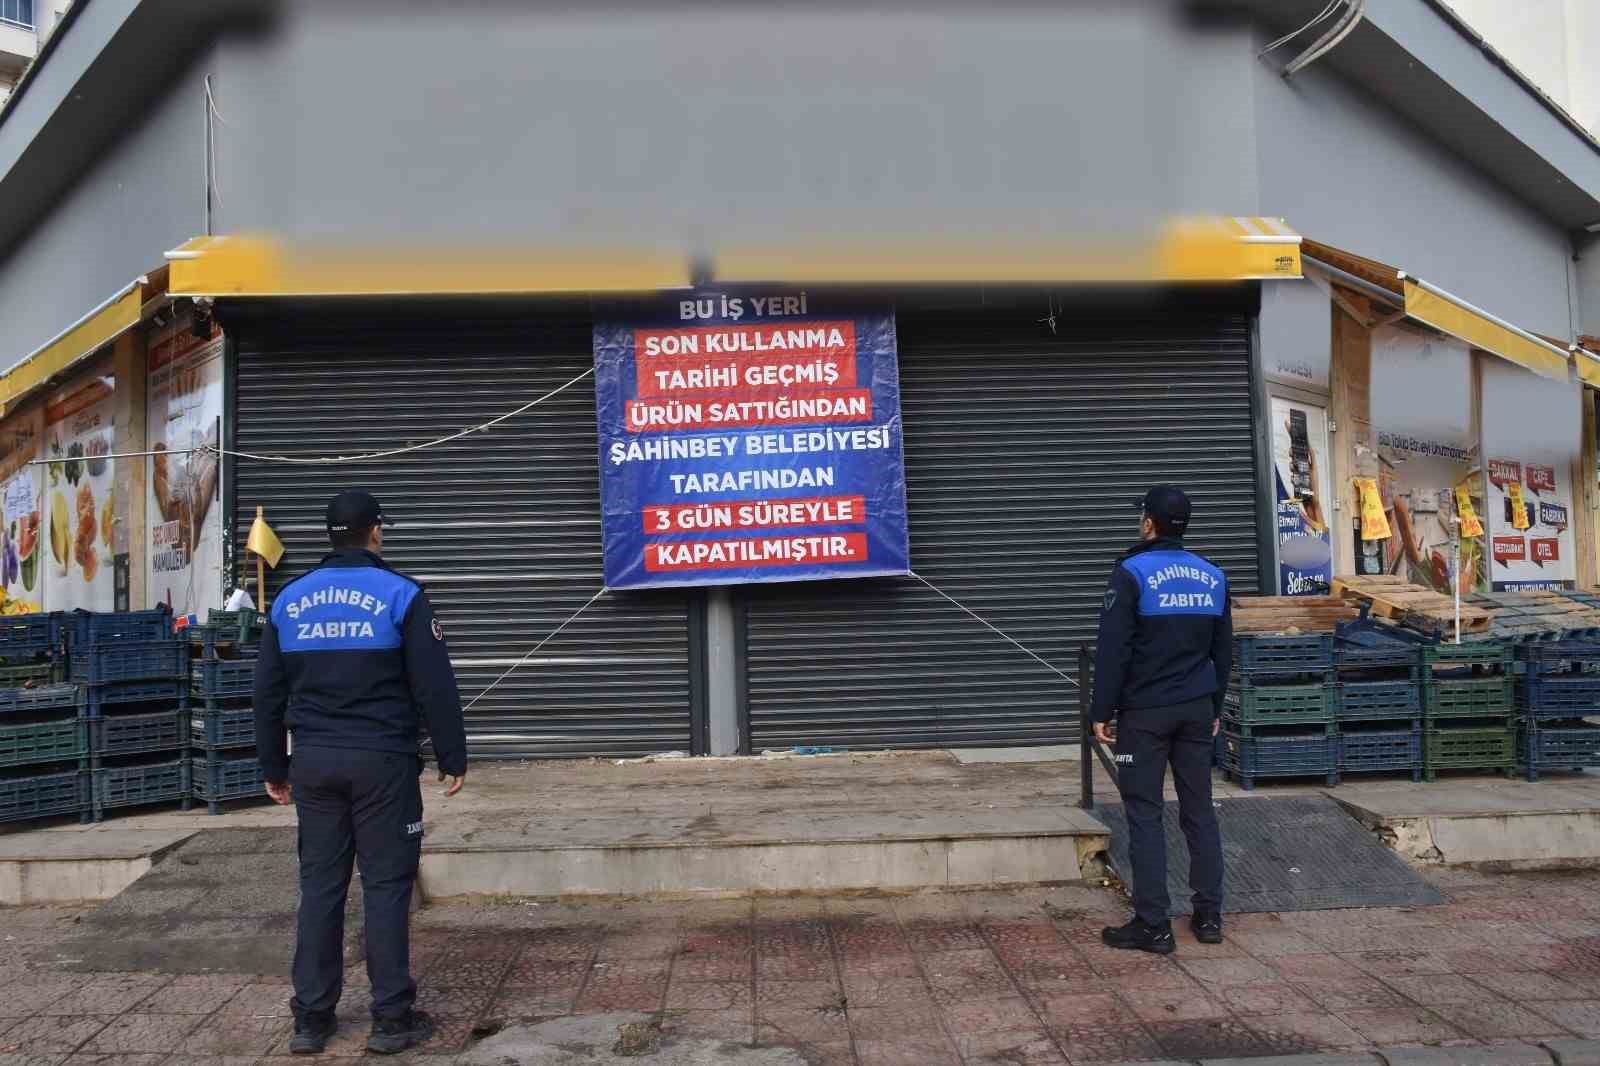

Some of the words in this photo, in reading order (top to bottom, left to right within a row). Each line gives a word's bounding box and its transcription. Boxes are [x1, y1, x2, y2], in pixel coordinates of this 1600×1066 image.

[679, 300, 714, 320] BU
[721, 295, 744, 320] İŞ
[750, 292, 808, 317] YERİ
[645, 334, 698, 356] SON
[705, 328, 845, 354] KULLANMA
[655, 362, 738, 390] TARİHİ
[744, 360, 840, 386] GEÇMİŞ
[631, 400, 703, 426] ÜRÜN
[709, 396, 867, 422] SATTIĞINDAN
[610, 435, 738, 466] ŞAHİNBEY
[745, 425, 890, 456] BELEDİYESİ
[669, 467, 834, 494] TARAFINDAN
[656, 510, 671, 530] 3
[677, 503, 732, 529] GÜN
[738, 500, 853, 525] SÜREYLE
[657, 536, 855, 566] KAPATILMIŞTIR.
[1147, 564, 1219, 590] ŞAHİNBEY
[286, 586, 387, 620] ŞAHİNBEY
[1159, 593, 1214, 608] ZABITA
[297, 621, 375, 640] ZABITA
